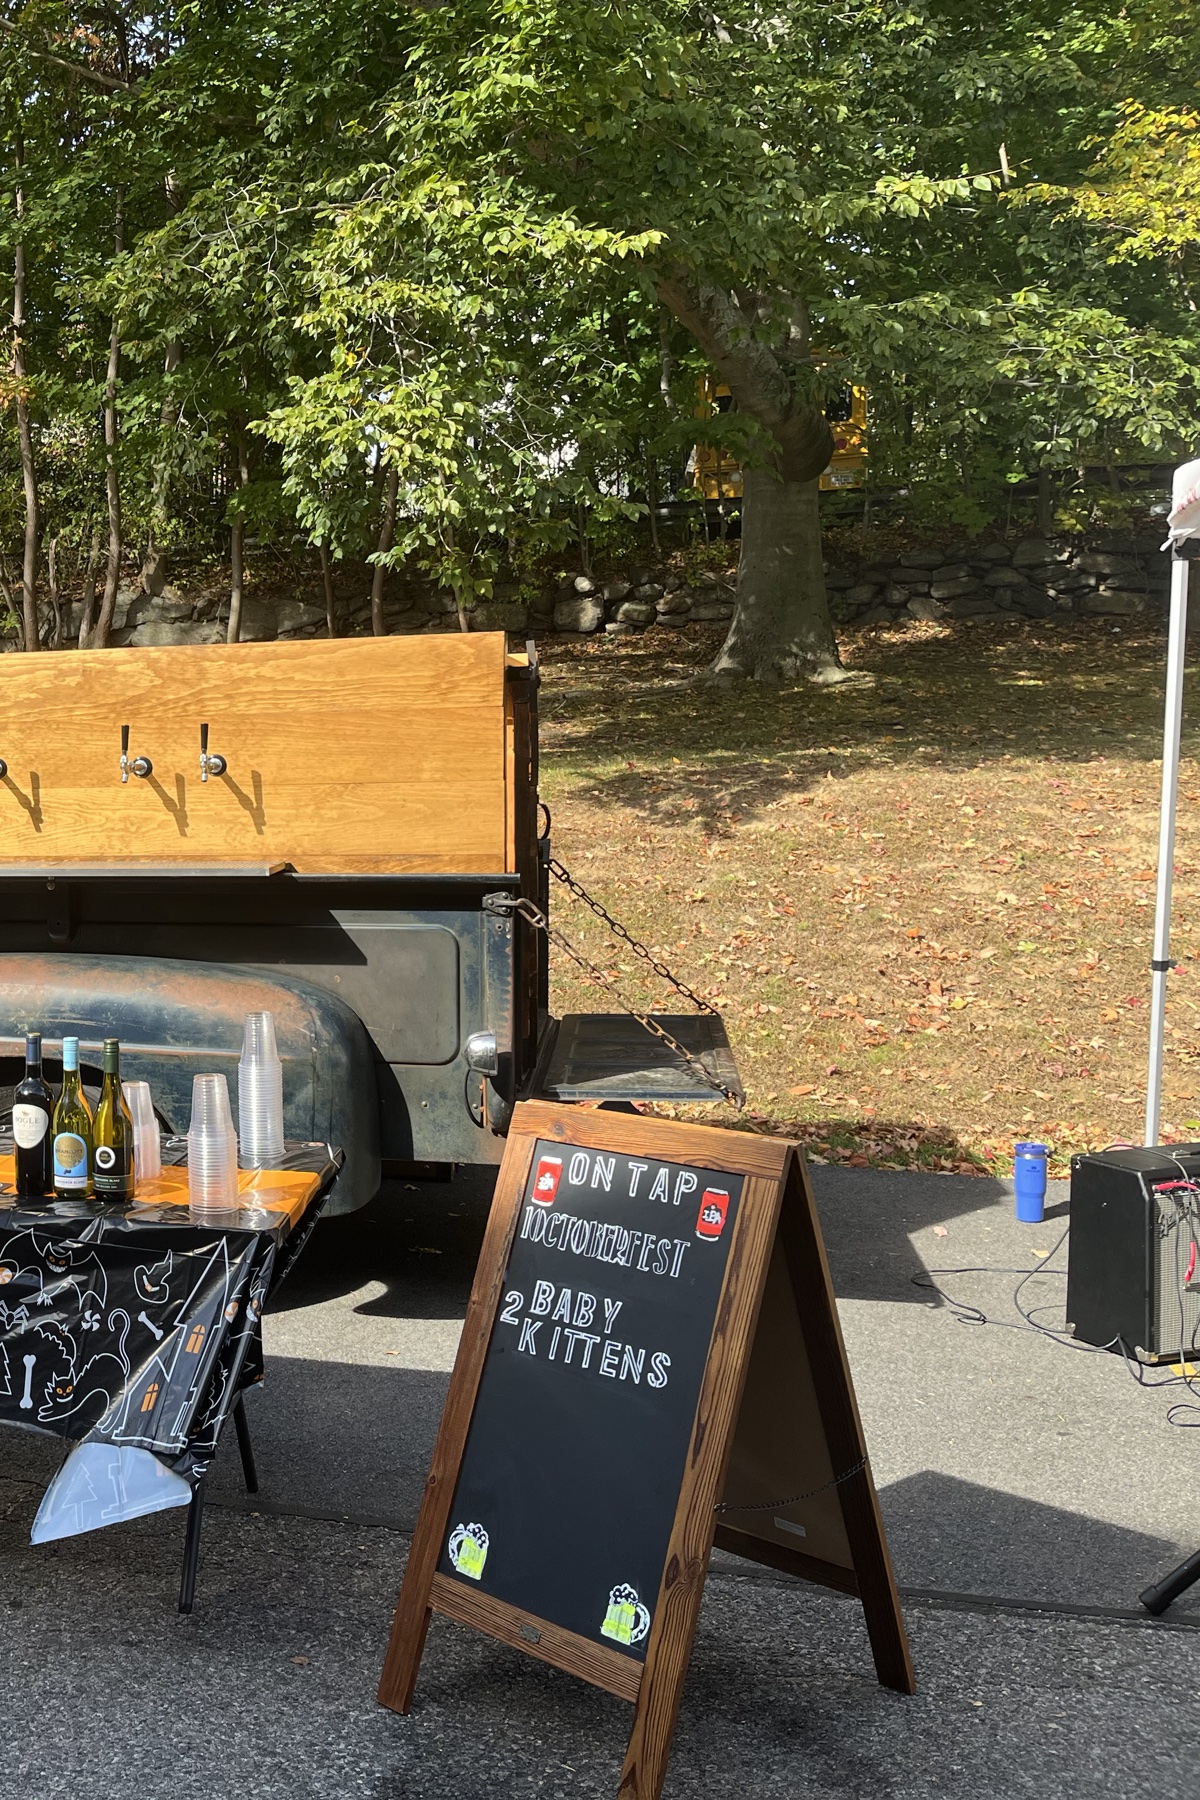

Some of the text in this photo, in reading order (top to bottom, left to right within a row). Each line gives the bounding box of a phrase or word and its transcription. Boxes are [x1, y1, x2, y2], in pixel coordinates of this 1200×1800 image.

[568, 1152, 698, 1206] ON TAP
[499, 1279, 623, 1335] 2 BABY
[517, 1317, 672, 1389] KITTENS
